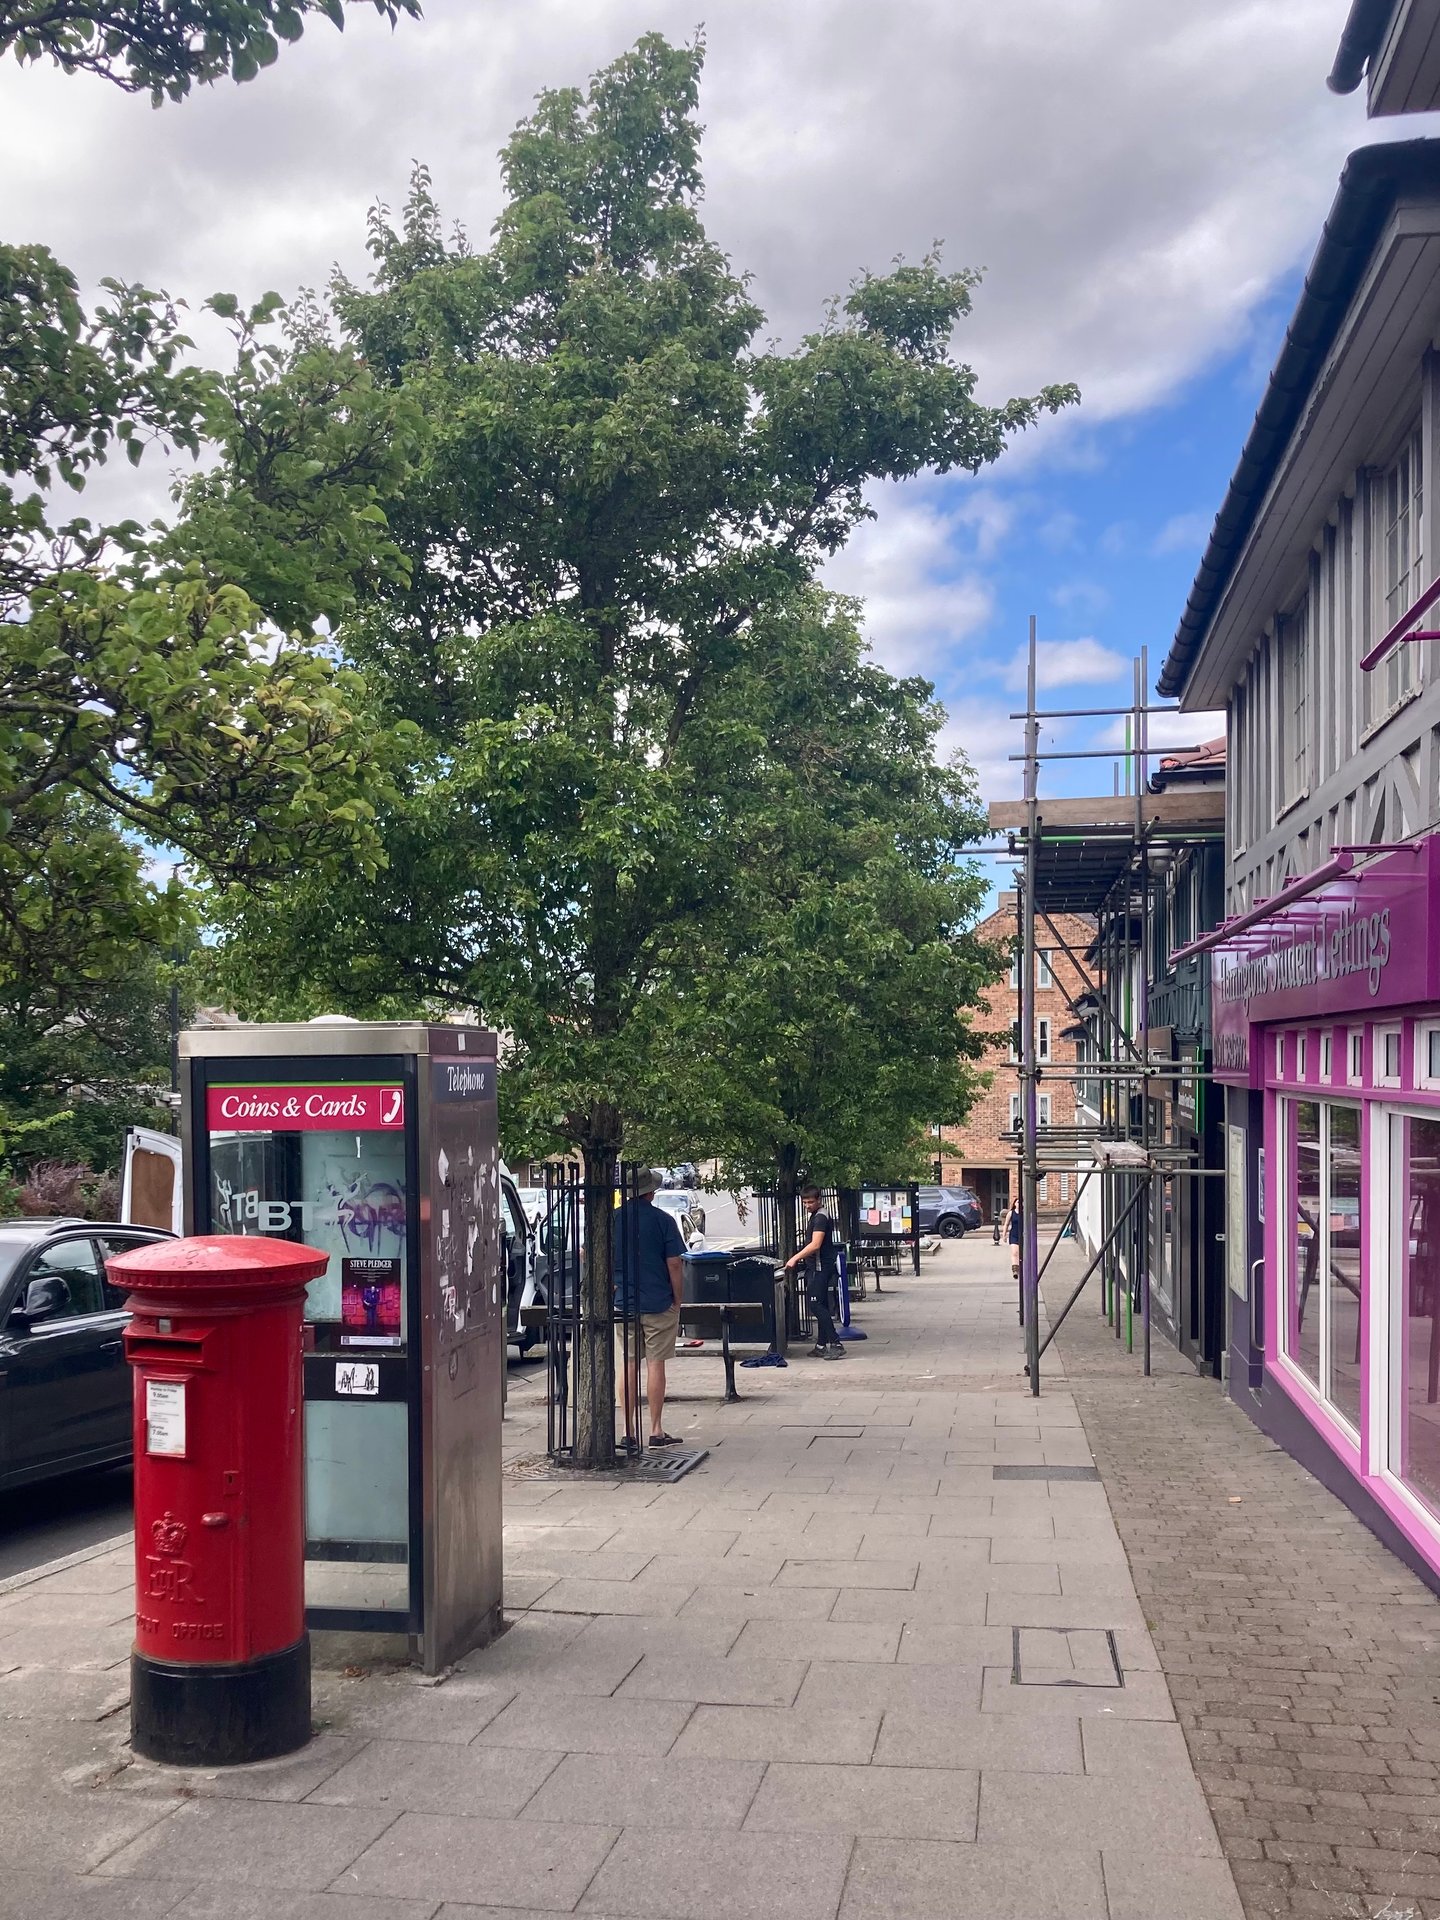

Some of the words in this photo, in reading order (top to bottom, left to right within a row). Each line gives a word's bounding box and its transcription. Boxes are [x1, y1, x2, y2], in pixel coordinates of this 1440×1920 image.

[1270, 923, 1318, 992] Student
[1320, 897, 1391, 997] Lettings
[447, 1066, 485, 1097] Telephone
[221, 1093, 279, 1119] Coins
[282, 1096, 302, 1118] &
[304, 1093, 367, 1118] Cards
[258, 1201, 318, 1231] BT
[350, 1260, 367, 1268] STEVE
[368, 1260, 392, 1268] PLEDGER
